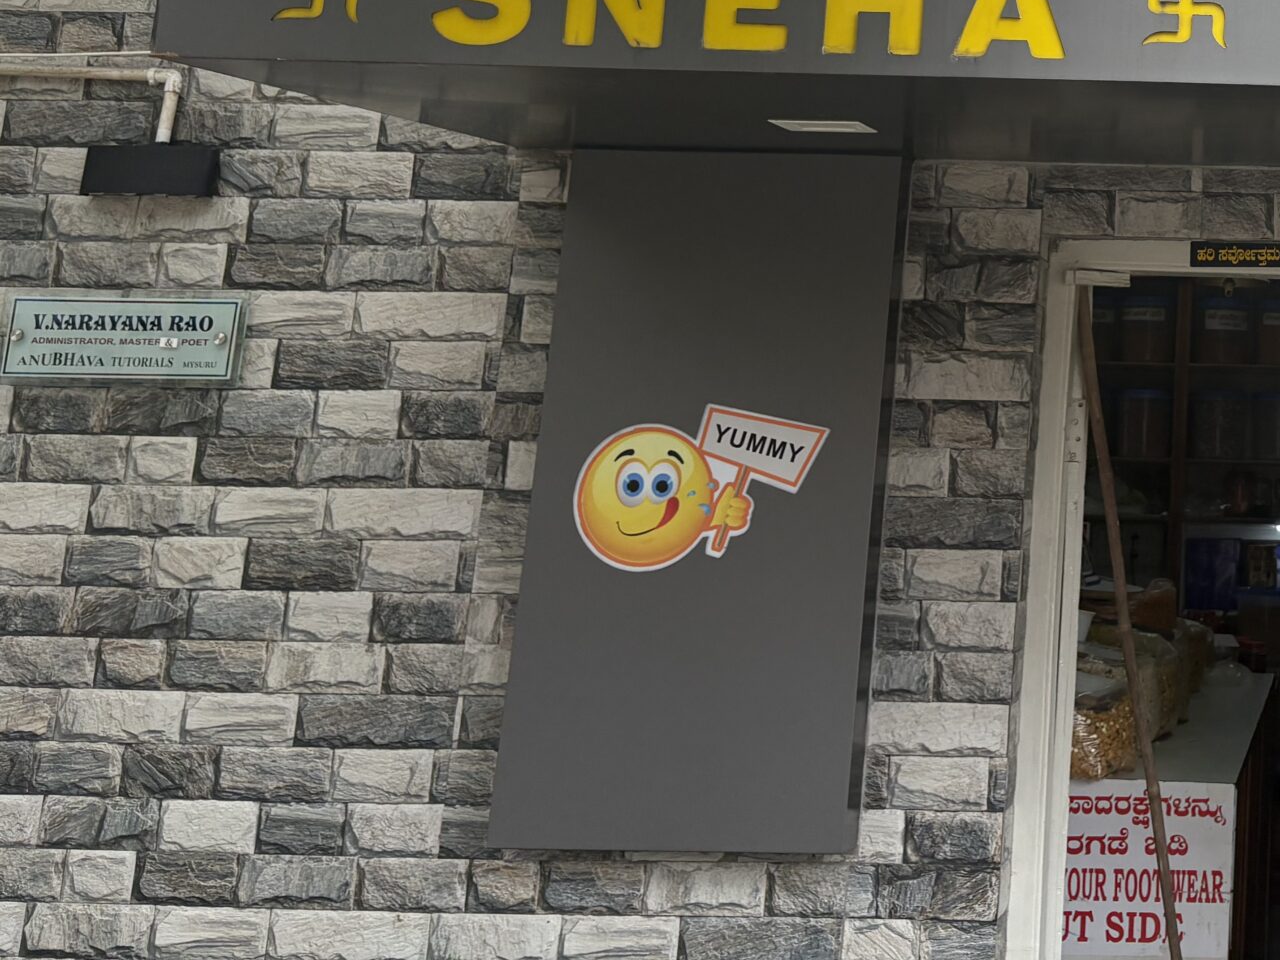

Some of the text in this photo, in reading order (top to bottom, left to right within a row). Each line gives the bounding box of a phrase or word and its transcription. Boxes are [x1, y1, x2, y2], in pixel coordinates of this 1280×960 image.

[168, 315, 214, 333] RAO
[119, 338, 160, 347] MASTER
[181, 338, 209, 347] POET
[111, 356, 174, 369] TUTORIALS
[716, 424, 806, 464] YUMMY
[1064, 867, 1107, 902] OUR
